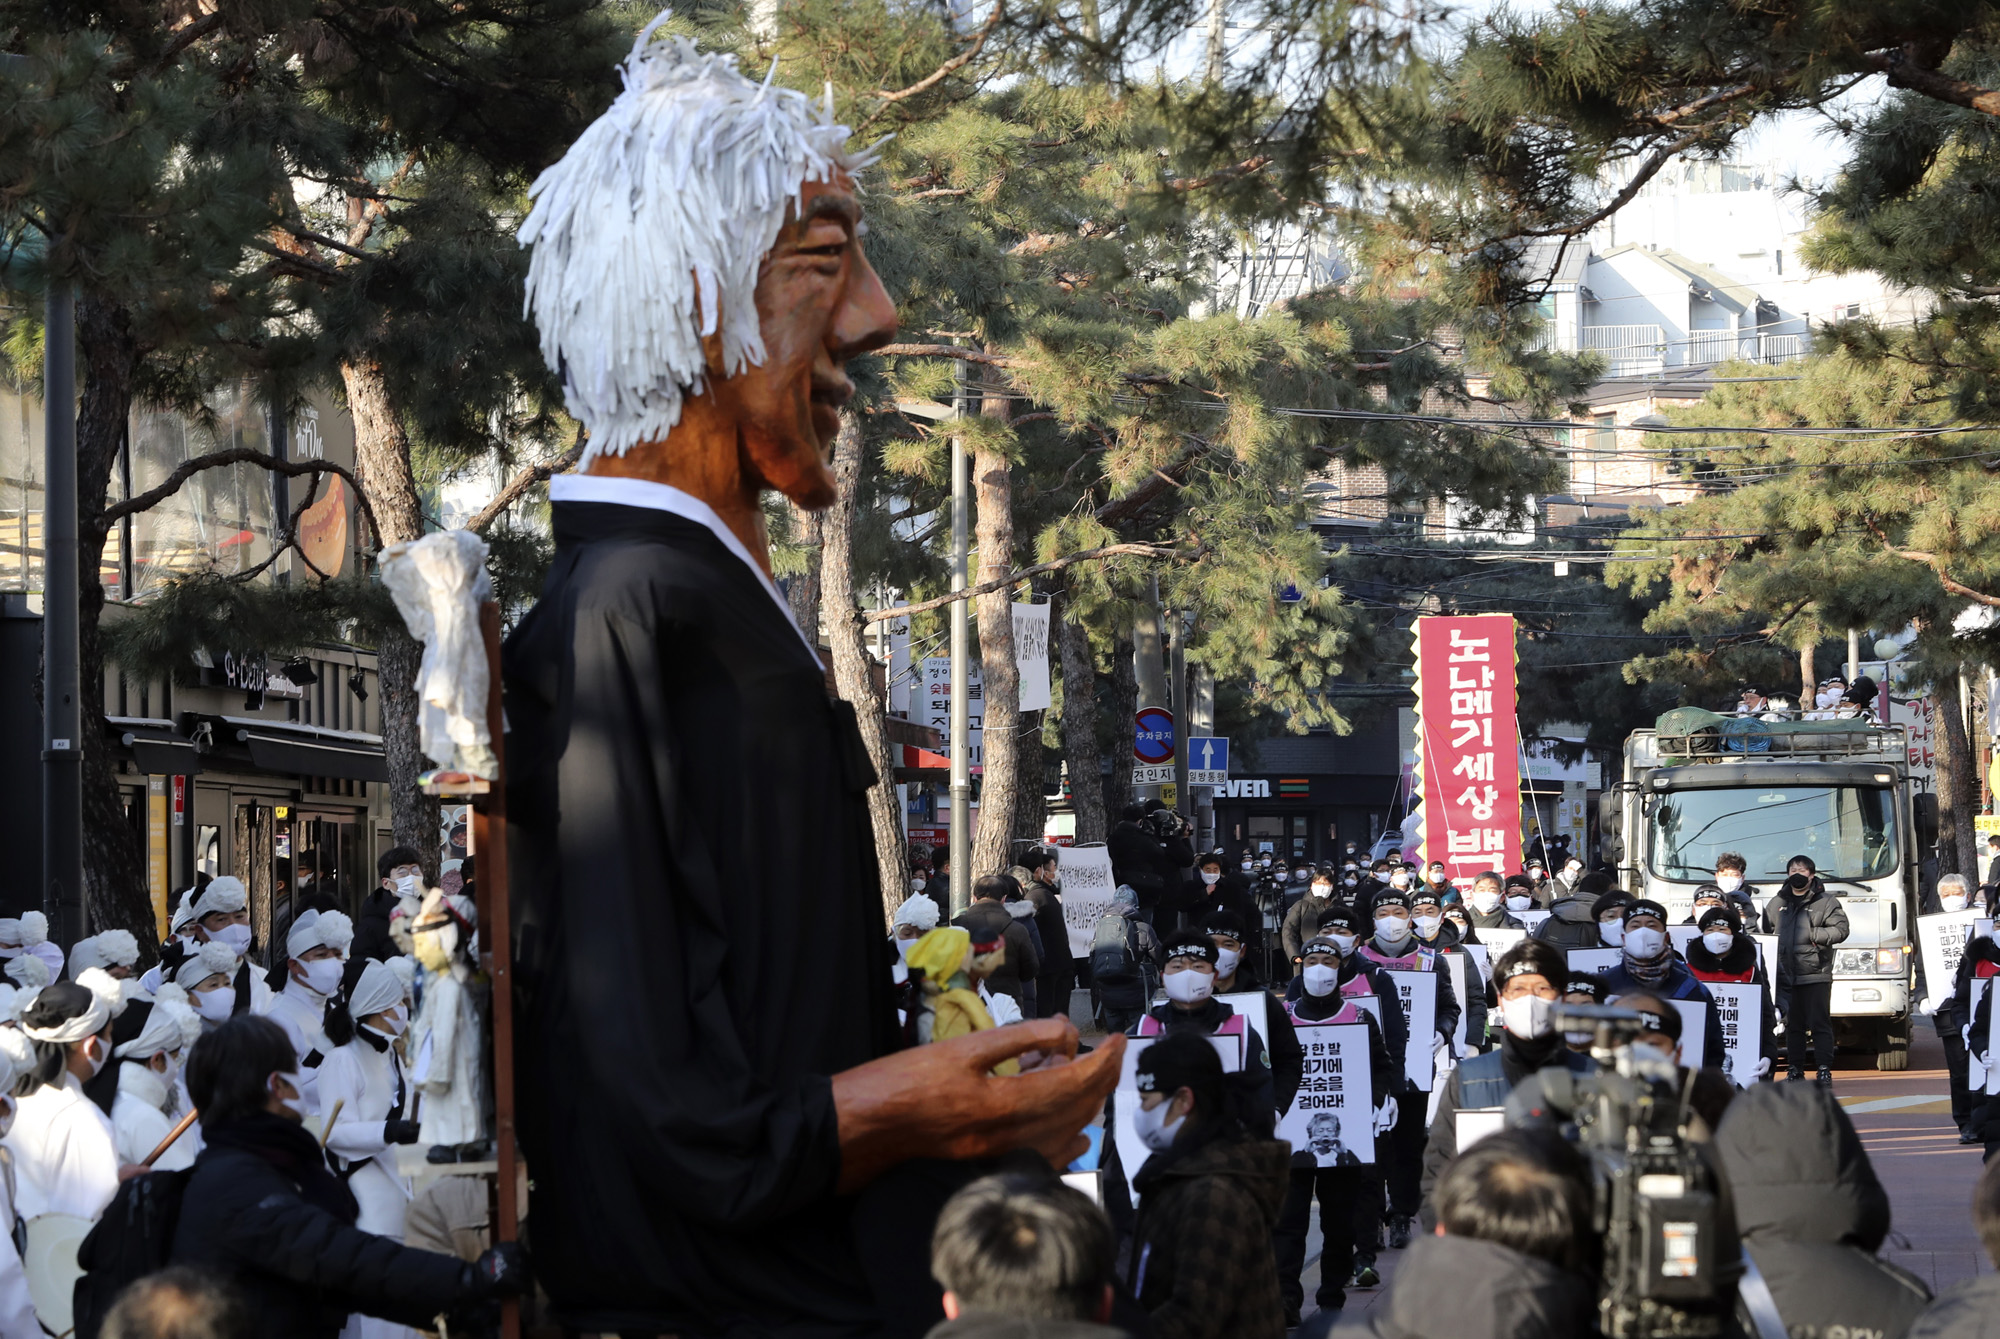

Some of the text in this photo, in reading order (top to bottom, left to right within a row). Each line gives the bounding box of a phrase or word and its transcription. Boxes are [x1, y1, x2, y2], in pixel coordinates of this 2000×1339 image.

[1136, 731, 1172, 741] 주차금지
[1134, 768, 1176, 782] 견인지
[1189, 771, 1225, 783] 일방통행
[1213, 779, 1270, 798] EVEn
[1168, 944, 1207, 958] 노동해방
[1942, 947, 1965, 958] 목숨
[1400, 985, 1412, 997] 발
[1728, 996, 1739, 1008] 발
[1717, 1009, 1739, 1022] 기에
[1311, 1043, 1325, 1056] 한
[1328, 1042, 1341, 1056] 발
[1723, 1038, 1738, 1049] 라!
[1298, 1076, 1344, 1092] 목숨을
[1298, 1094, 1345, 1110] 걸어라!
